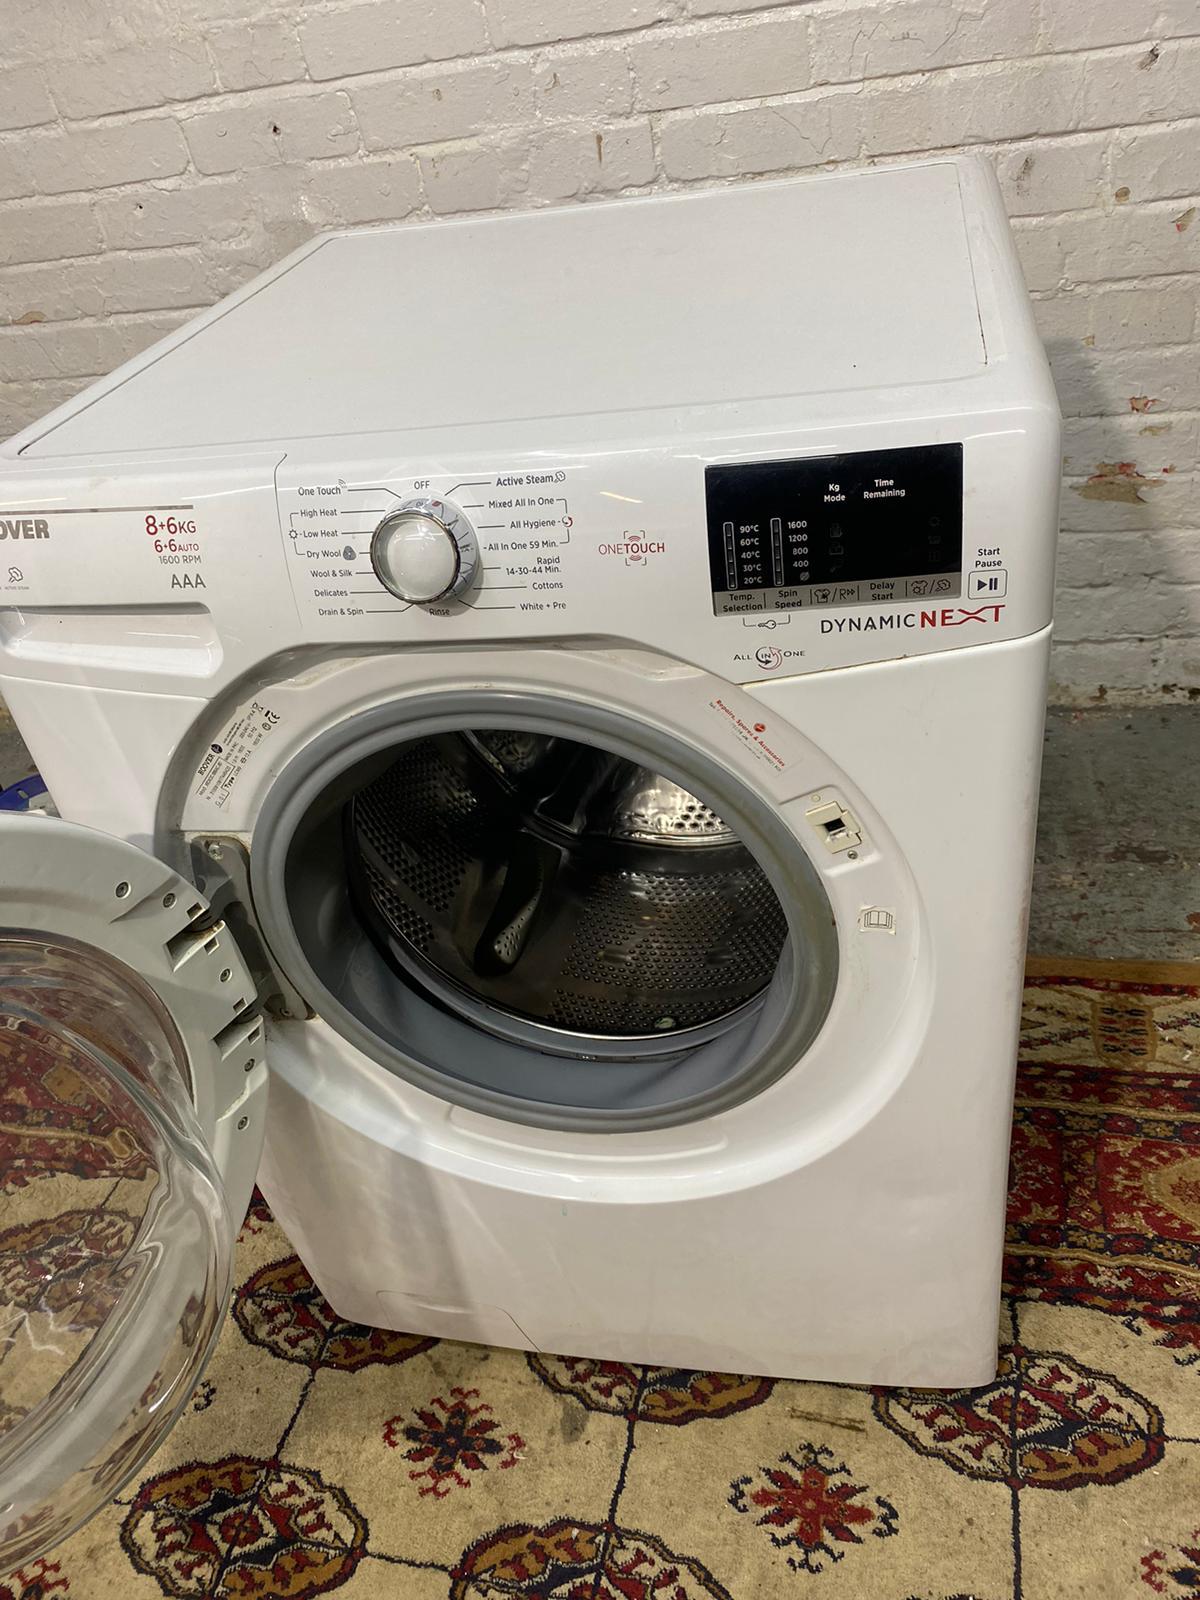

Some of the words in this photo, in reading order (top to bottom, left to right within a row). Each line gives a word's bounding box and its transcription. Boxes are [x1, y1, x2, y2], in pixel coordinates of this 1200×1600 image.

[414, 480, 430, 490] OFF
[496, 476, 525, 487] Active
[526, 474, 554, 485] Steam
[874, 479, 895, 488] Time
[298, 487, 315, 496] One
[316, 486, 341, 495] Touch
[828, 484, 840, 493] Kg
[824, 493, 846, 502] Mode
[864, 488, 906, 499] Remaining
[488, 500, 512, 509] Mixed
[515, 499, 527, 507] All
[528, 498, 536, 506] In
[537, 497, 554, 506] One
[300, 509, 318, 518] High
[320, 508, 338, 516] Heat
[510, 521, 522, 529] All
[523, 519, 556, 530] Hygiene
[740, 524, 760, 533] 90°C
[788, 520, 807, 529] 1600
[303, 530, 319, 538] Low
[320, 529, 338, 537] Heat
[788, 534, 808, 542] 1200
[488, 543, 499, 551] All
[501, 543, 509, 551] In
[511, 541, 527, 550] One
[529, 541, 540, 549] 59
[541, 540, 558, 549] Min.
[740, 538, 760, 546] 60°C
[307, 551, 320, 559] Dry
[322, 550, 341, 558] Wool
[741, 551, 760, 559] 40°C
[792, 547, 808, 555] 800
[977, 547, 1001, 556] Start
[159, 555, 180, 564] 1600
[182, 555, 201, 564] RPM
[537, 556, 560, 567] Rapid
[975, 559, 1002, 568] Pause
[506, 566, 543, 576] 14-30-44
[544, 564, 562, 574] Min.
[743, 564, 762, 572] 30°C
[311, 570, 330, 578] Wool
[339, 569, 353, 577] Silk
[171, 574, 206, 589] AAA
[532, 582, 563, 590] Cottons
[869, 581, 895, 591] Delay
[314, 589, 348, 597] Delicates
[778, 589, 798, 599] Spin
[871, 592, 893, 601] Start
[729, 593, 755, 603] Temp.
[520, 602, 544, 611] White
[552, 601, 566, 610] Pre
[723, 602, 763, 612] Selection
[775, 599, 802, 610] Speed
[318, 608, 339, 616] Drain
[346, 607, 364, 617] Spin
[429, 608, 450, 616] Rinse
[733, 653, 752, 661] ALL
[783, 650, 806, 658] ONE
[736, 718, 753, 737] Spares
